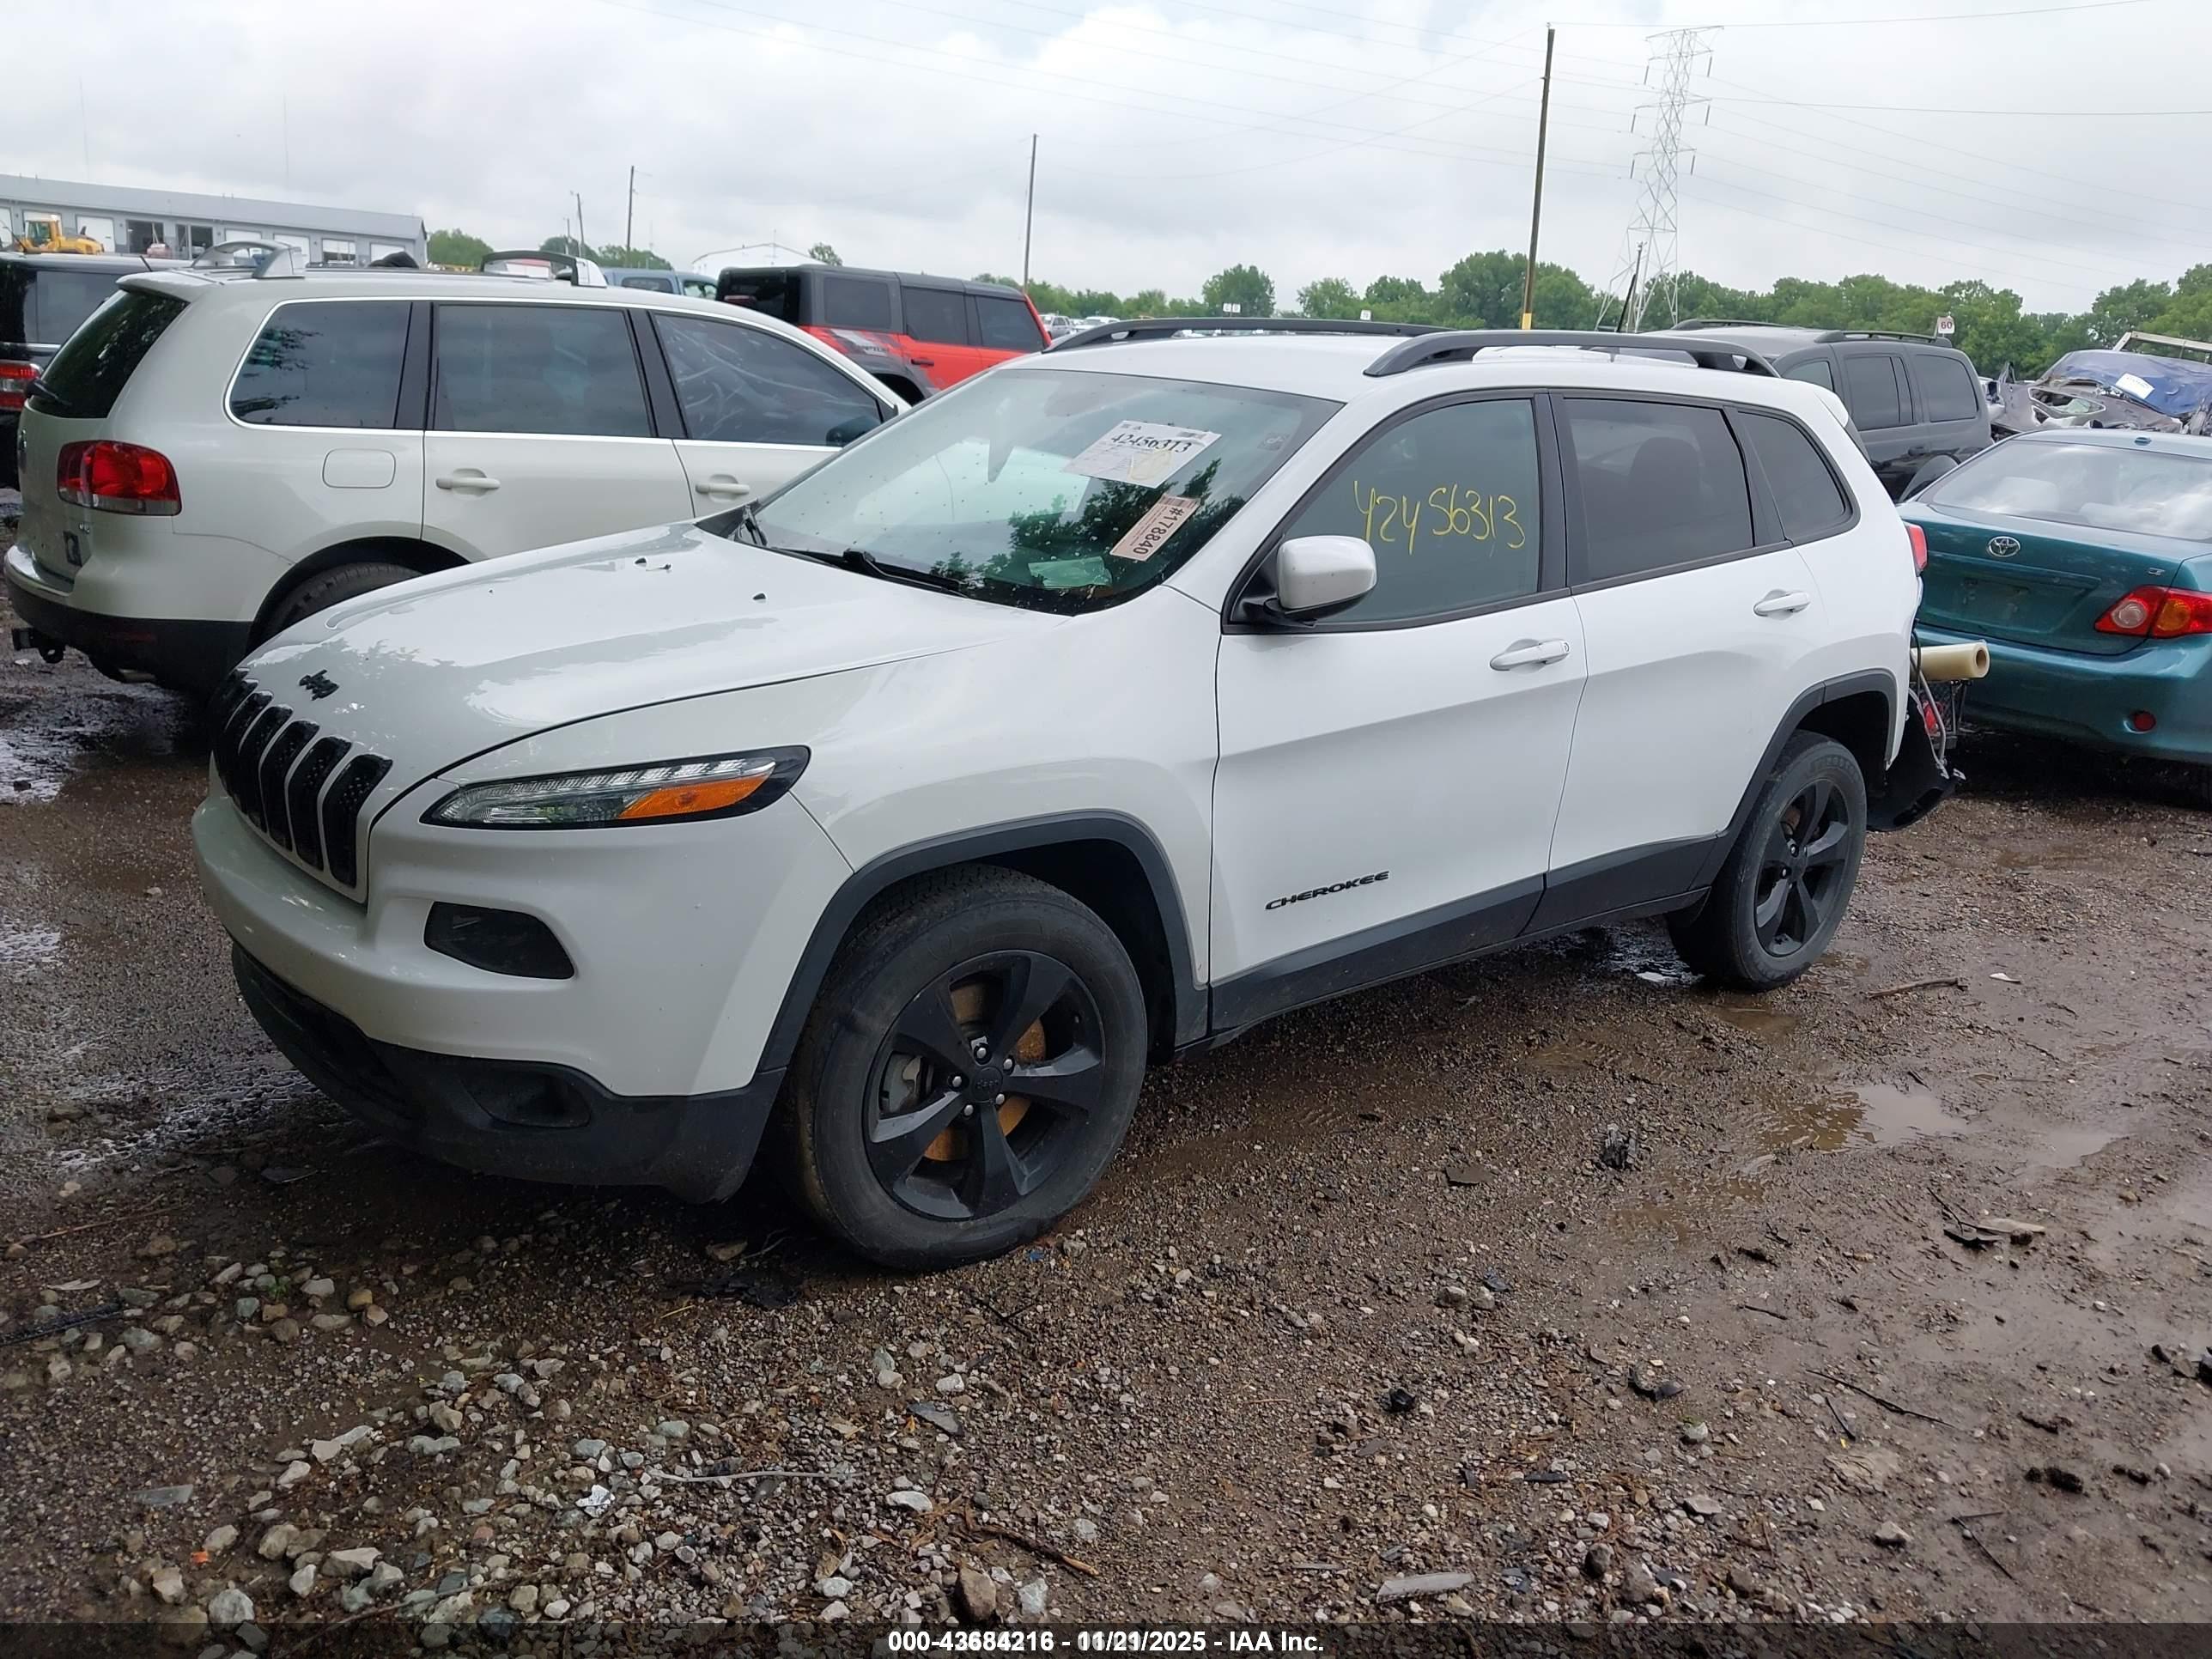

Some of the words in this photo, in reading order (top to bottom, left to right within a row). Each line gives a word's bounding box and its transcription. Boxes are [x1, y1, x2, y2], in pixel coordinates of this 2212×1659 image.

[1941, 321, 1953, 330] 60
[1111, 433, 1193, 453] 42456313
[1133, 507, 1184, 555] #178840
[1353, 480, 1526, 556] 42456313
[1265, 871, 1389, 910] CHEROKEE
